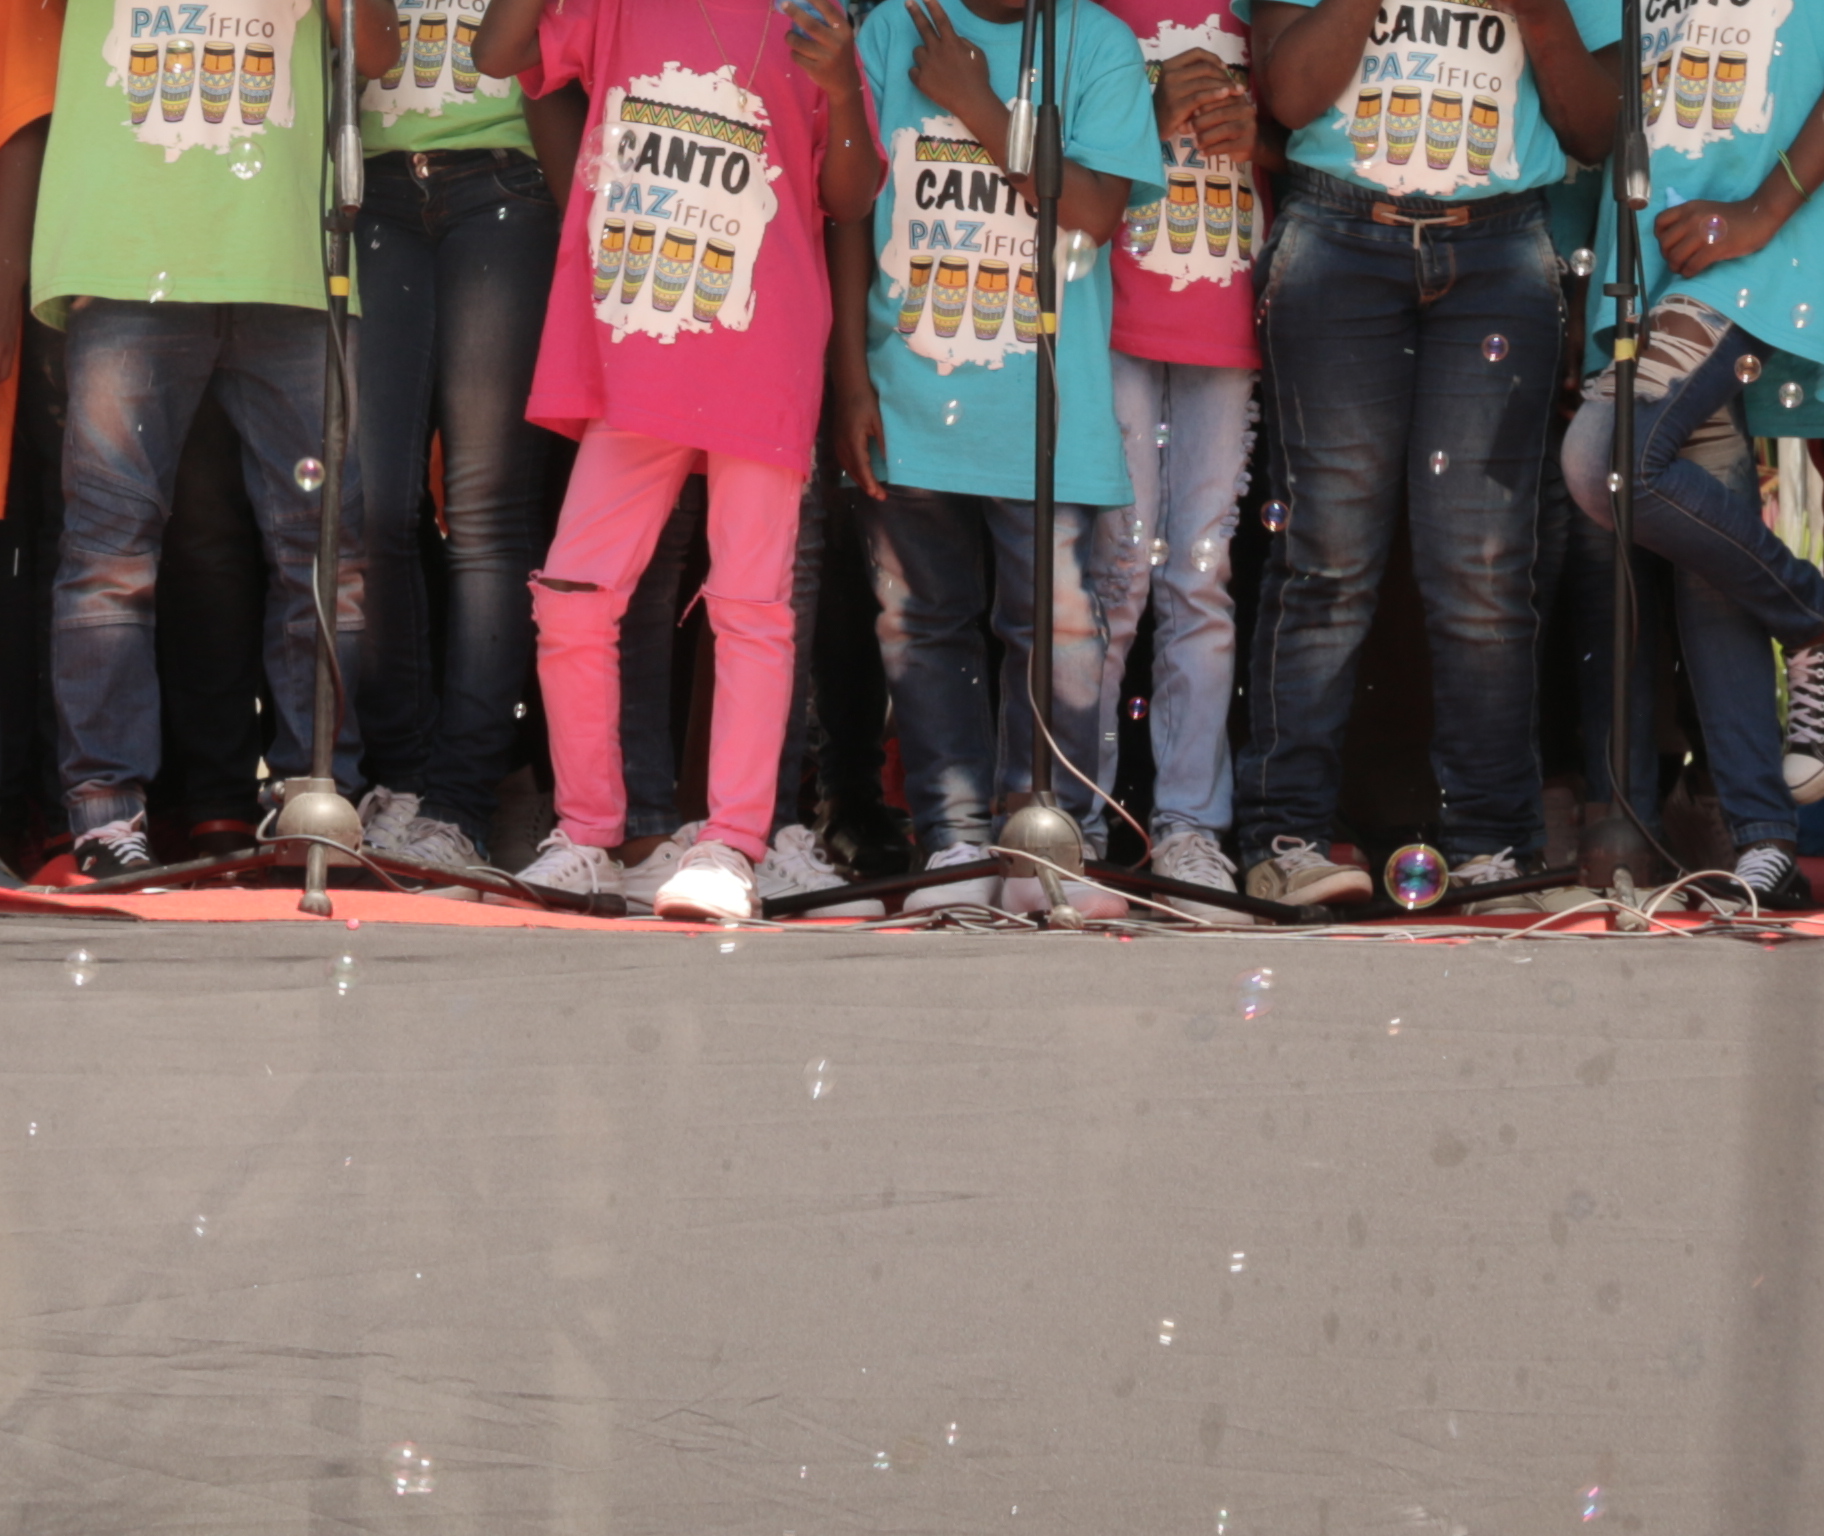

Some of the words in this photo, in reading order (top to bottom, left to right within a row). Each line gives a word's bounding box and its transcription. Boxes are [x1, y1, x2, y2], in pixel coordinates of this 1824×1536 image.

[131, 4, 275, 39] PAZÍFICO
[1369, 5, 1506, 54] CANTO
[1360, 51, 1502, 93] PAZÍFICO
[617, 129, 750, 195] CANTO
[607, 180, 741, 237] PAZÍFICO
[908, 219, 1037, 257] PAZÍFIC
